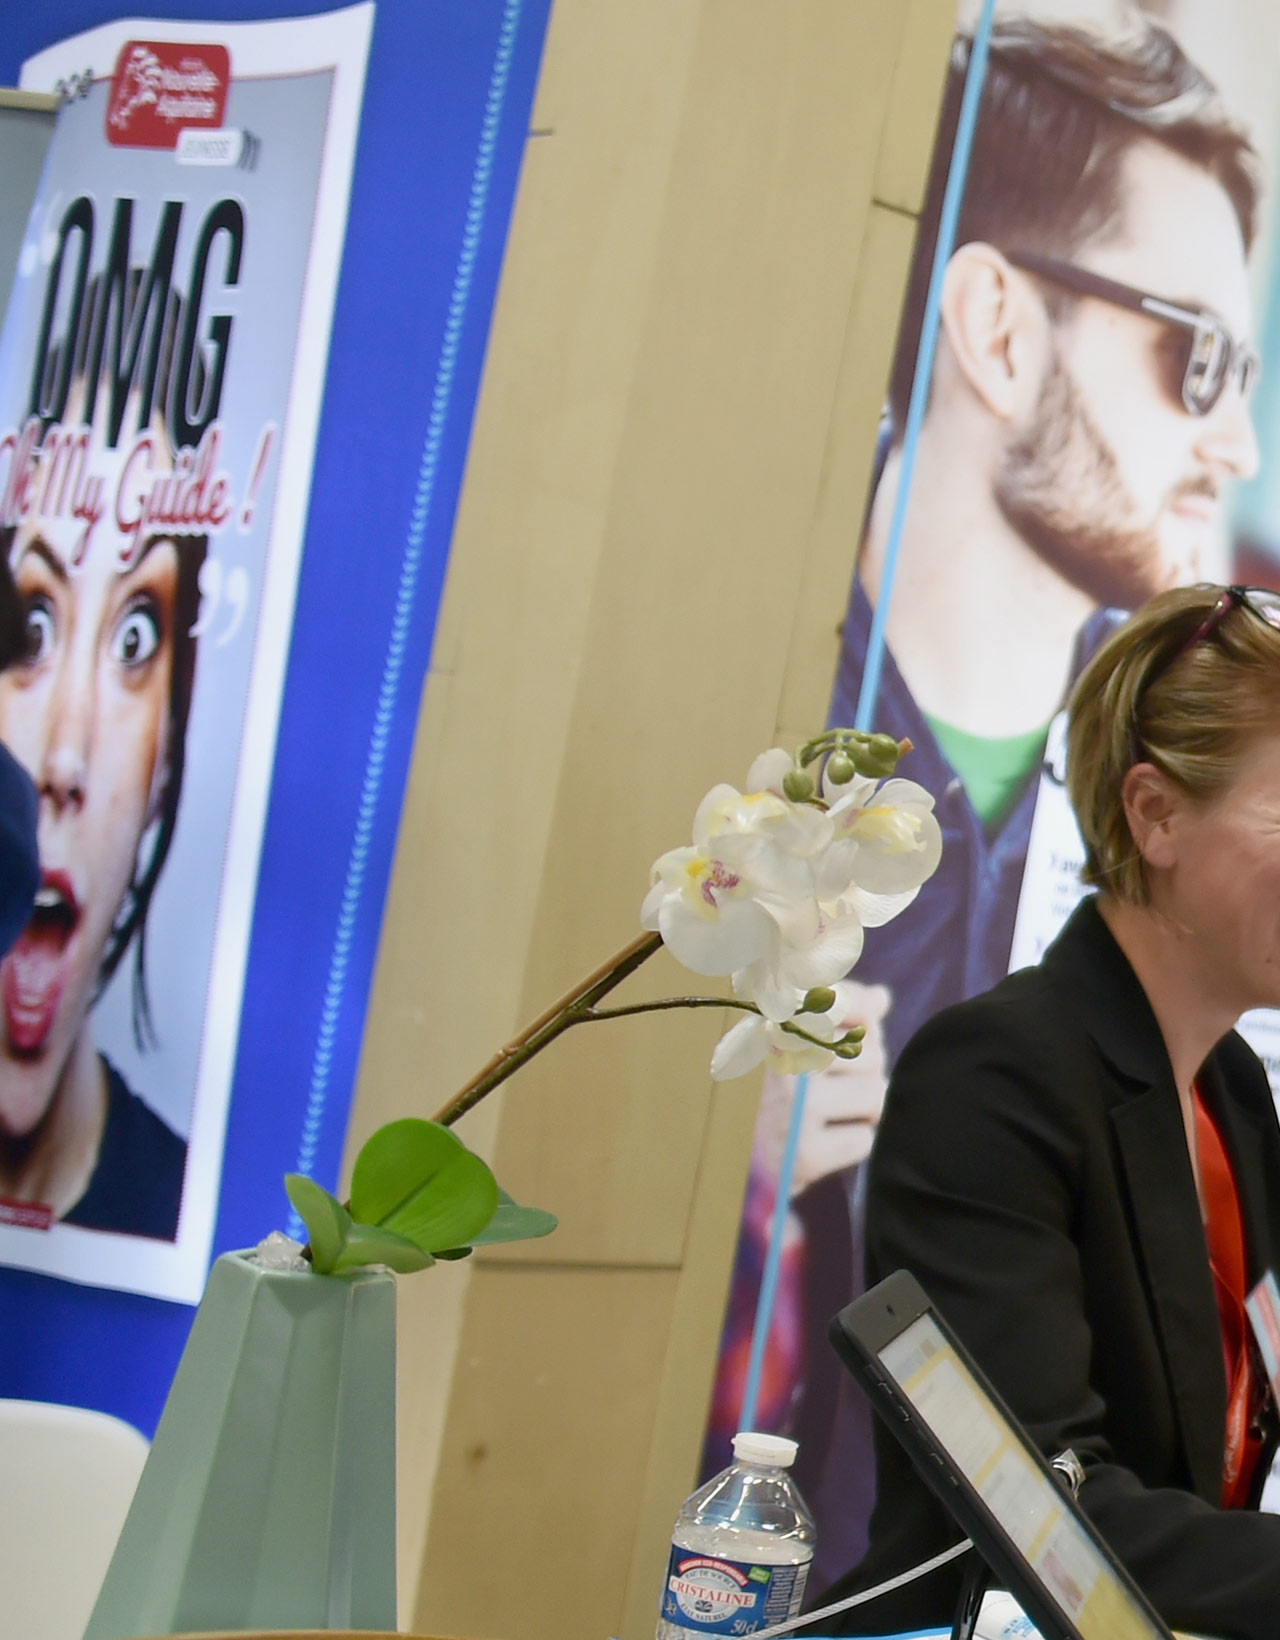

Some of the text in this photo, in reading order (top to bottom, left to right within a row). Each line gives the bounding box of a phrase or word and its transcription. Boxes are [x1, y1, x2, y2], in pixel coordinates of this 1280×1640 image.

[30, 197, 245, 449] OMG
[40, 432, 104, 567] My
[116, 428, 231, 563] Guide
[670, 1577, 755, 1607] CRISTALINE
